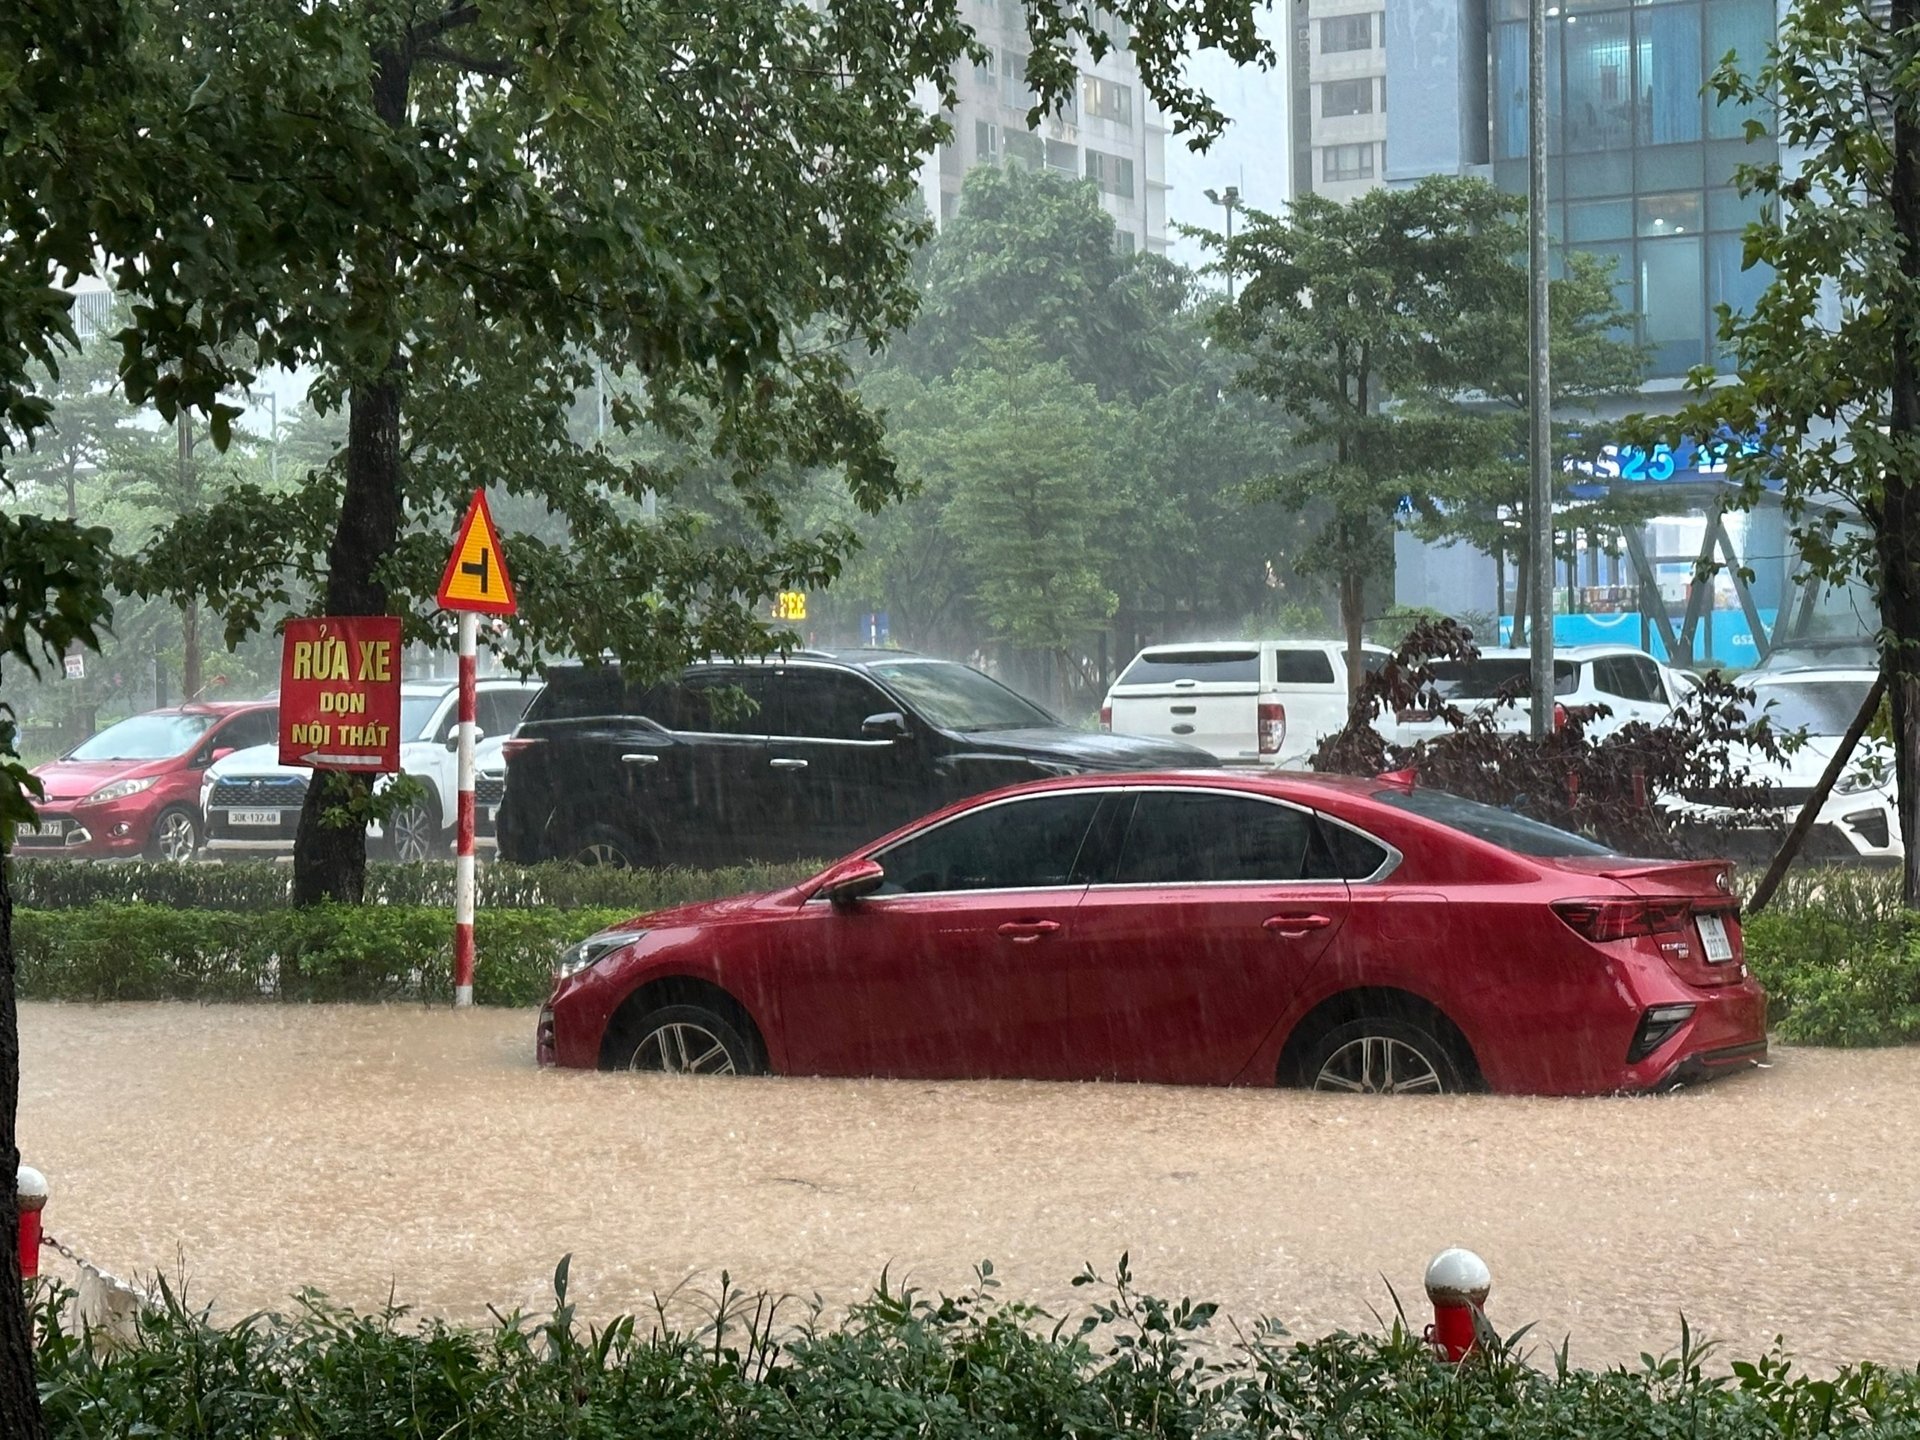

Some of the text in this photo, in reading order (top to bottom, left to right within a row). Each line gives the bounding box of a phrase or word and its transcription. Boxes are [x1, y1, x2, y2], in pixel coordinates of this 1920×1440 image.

[293, 624, 391, 681] RỬA XE
[1732, 634, 1755, 646] GS2
[320, 692, 365, 717] DỌN
[292, 719, 390, 749] NỘI THẤT
